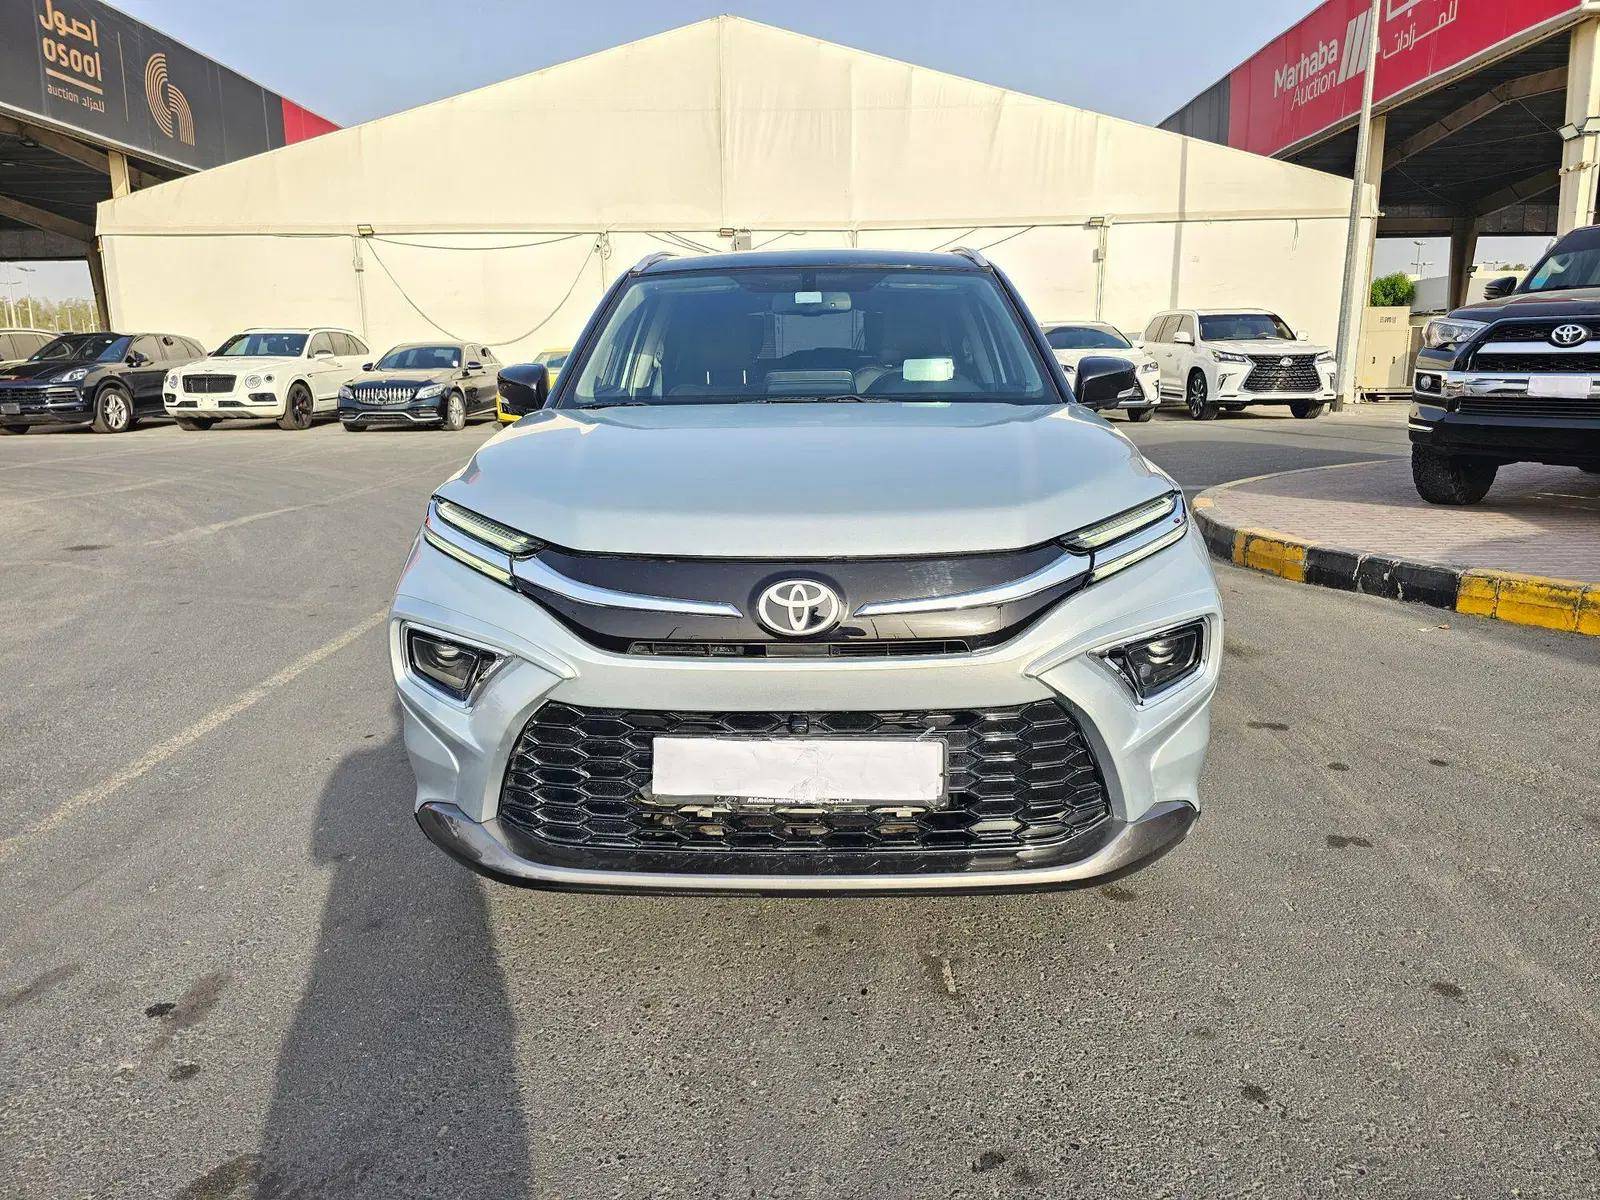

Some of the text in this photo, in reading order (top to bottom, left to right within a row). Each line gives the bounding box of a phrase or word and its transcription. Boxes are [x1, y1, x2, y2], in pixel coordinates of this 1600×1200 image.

[39, 0, 98, 47] اصول
[42, 37, 102, 81] osool
[1273, 38, 1339, 98] Marhaba
[47, 84, 80, 104] auction
[1290, 69, 1337, 112] Auction
